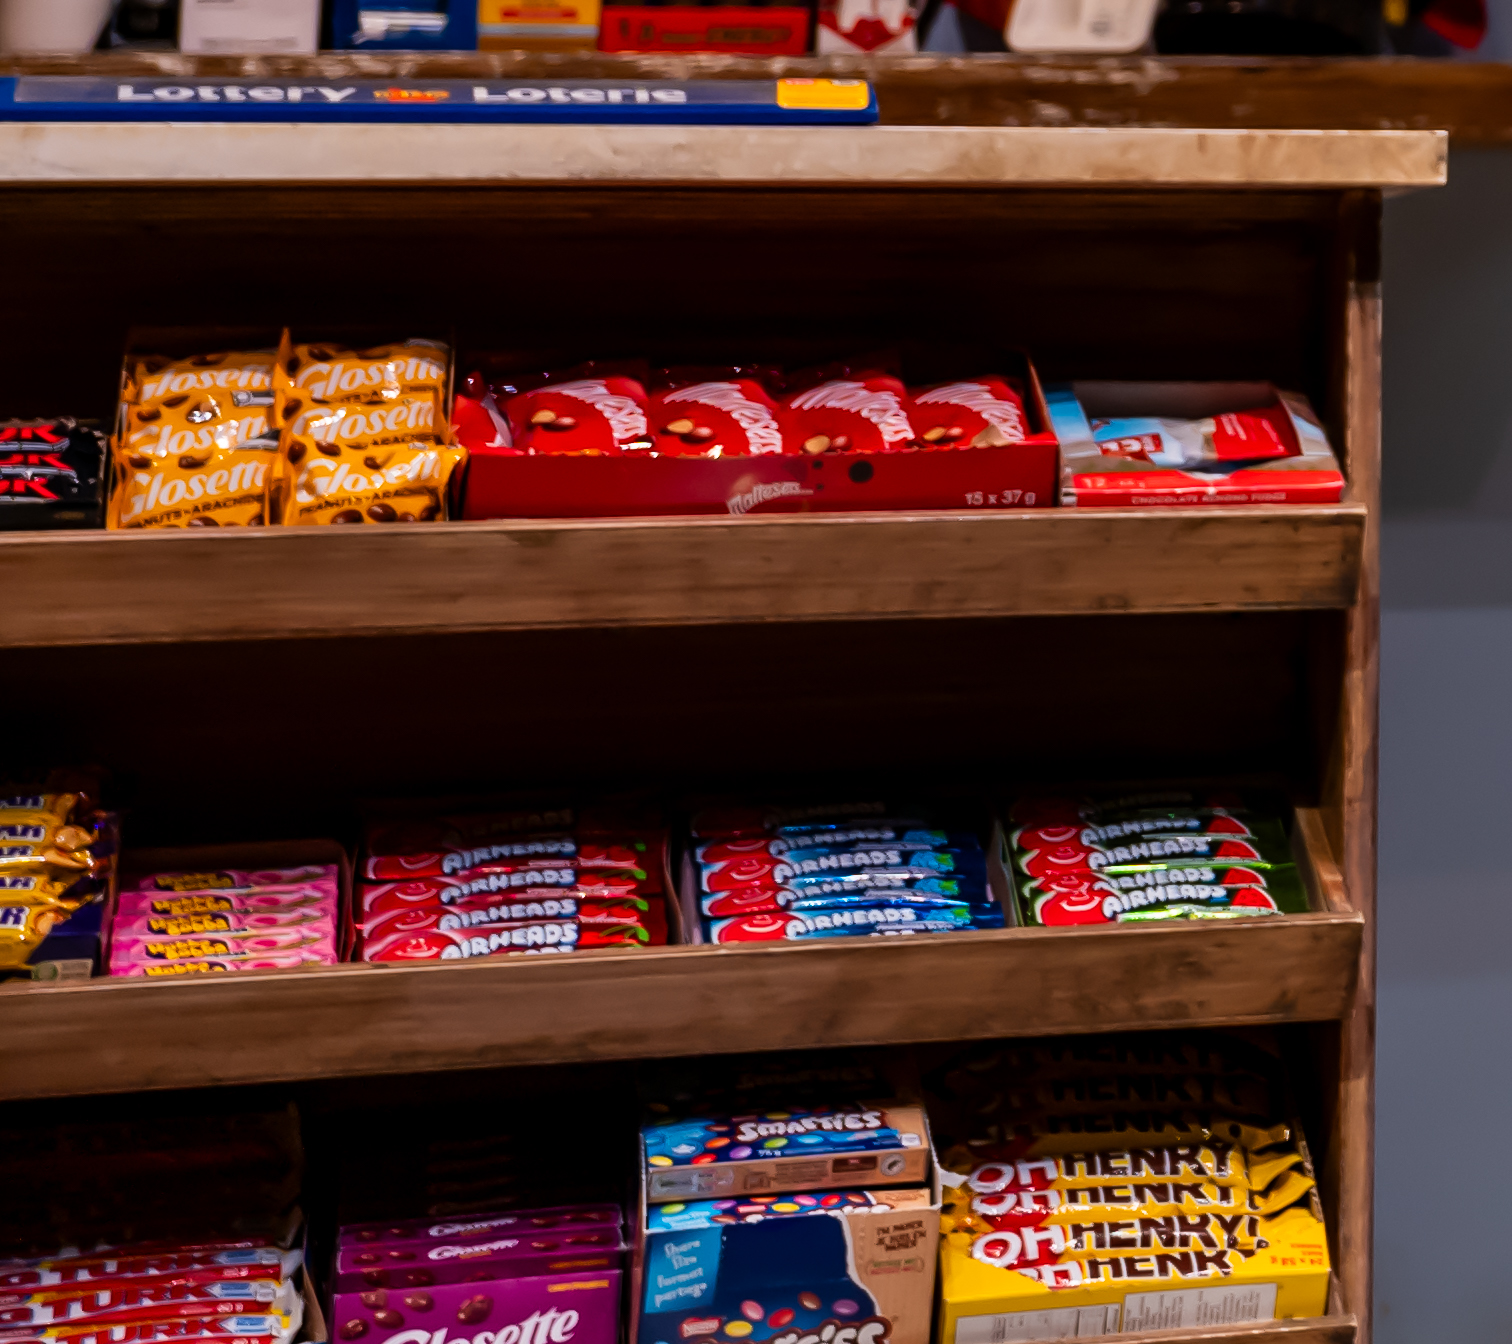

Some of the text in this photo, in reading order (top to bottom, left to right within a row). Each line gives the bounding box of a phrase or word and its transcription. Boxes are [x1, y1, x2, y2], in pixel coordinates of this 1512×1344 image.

[116, 84, 357, 103] Lottery
[473, 84, 687, 103] Loterie
[1079, 817, 1201, 847] AIRHEADS
[441, 839, 577, 875] AIRHEADS
[772, 850, 902, 884] AIRHEADS
[1086, 836, 1211, 869] AIRHEADS
[439, 869, 577, 903] AIRHEADS
[1101, 884, 1227, 920] AIRHEADS
[437, 898, 578, 930] AIRHEADS
[784, 907, 918, 938] AIRHEADS
[440, 922, 579, 960] AIRHEADS
[967, 1155, 1059, 1194] OH
[971, 1224, 1066, 1269] OH
[1069, 1213, 1270, 1252] HENRY!
[35, 1286, 208, 1322] TURK
